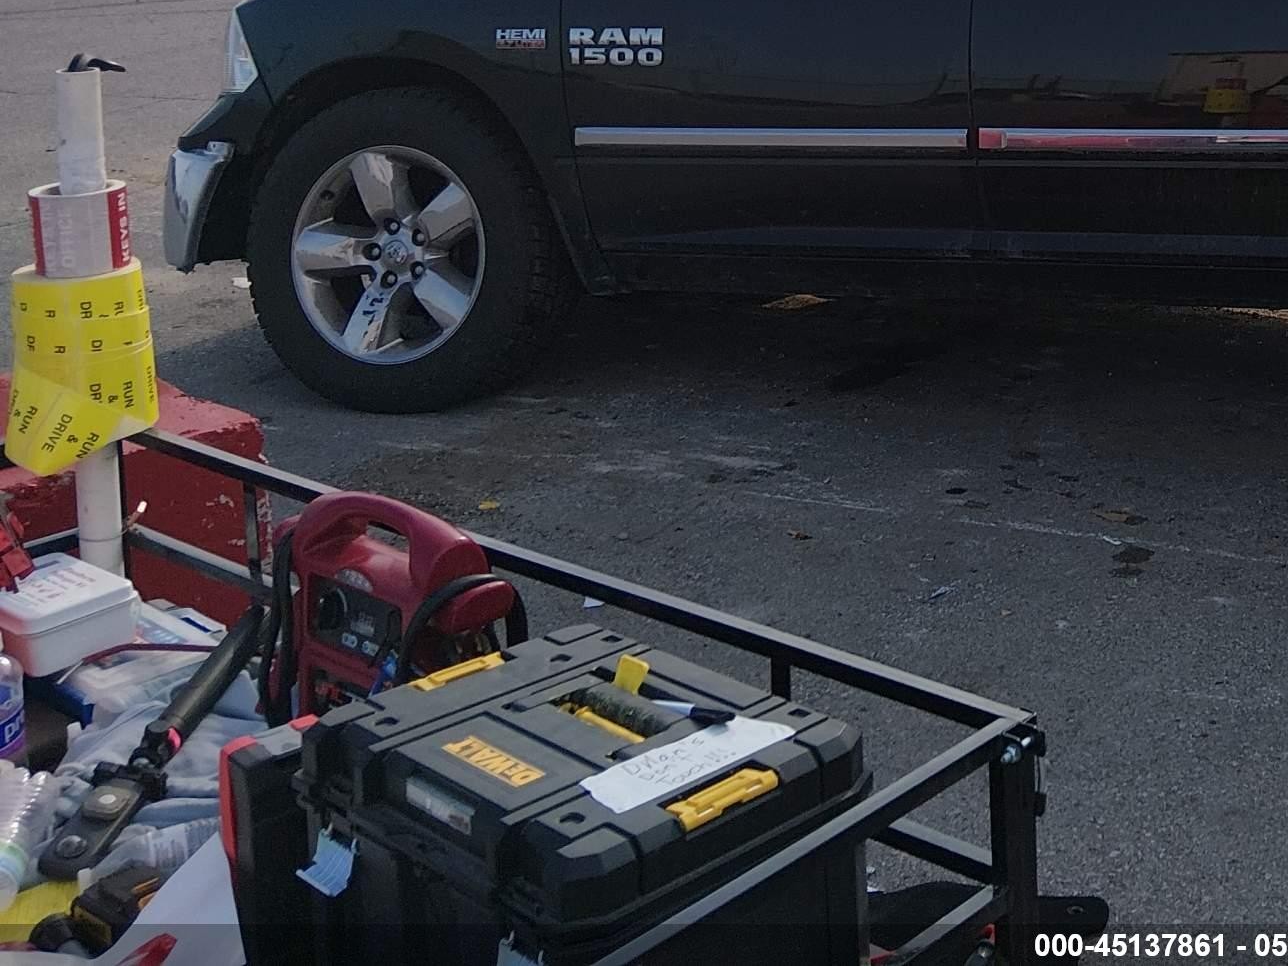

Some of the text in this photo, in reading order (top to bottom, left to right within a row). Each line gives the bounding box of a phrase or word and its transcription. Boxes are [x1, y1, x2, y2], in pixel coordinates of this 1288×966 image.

[495, 28, 546, 40] HEMI
[569, 27, 664, 45] RAM
[569, 47, 664, 66] 1500
[117, 192, 130, 262] KEYS IN
[107, 395, 118, 404] &
[122, 381, 135, 408] RUN
[18, 405, 38, 434] RUN
[41, 413, 73, 453] DRIVE
[66, 434, 79, 444] &
[75, 431, 100, 459] RUN
